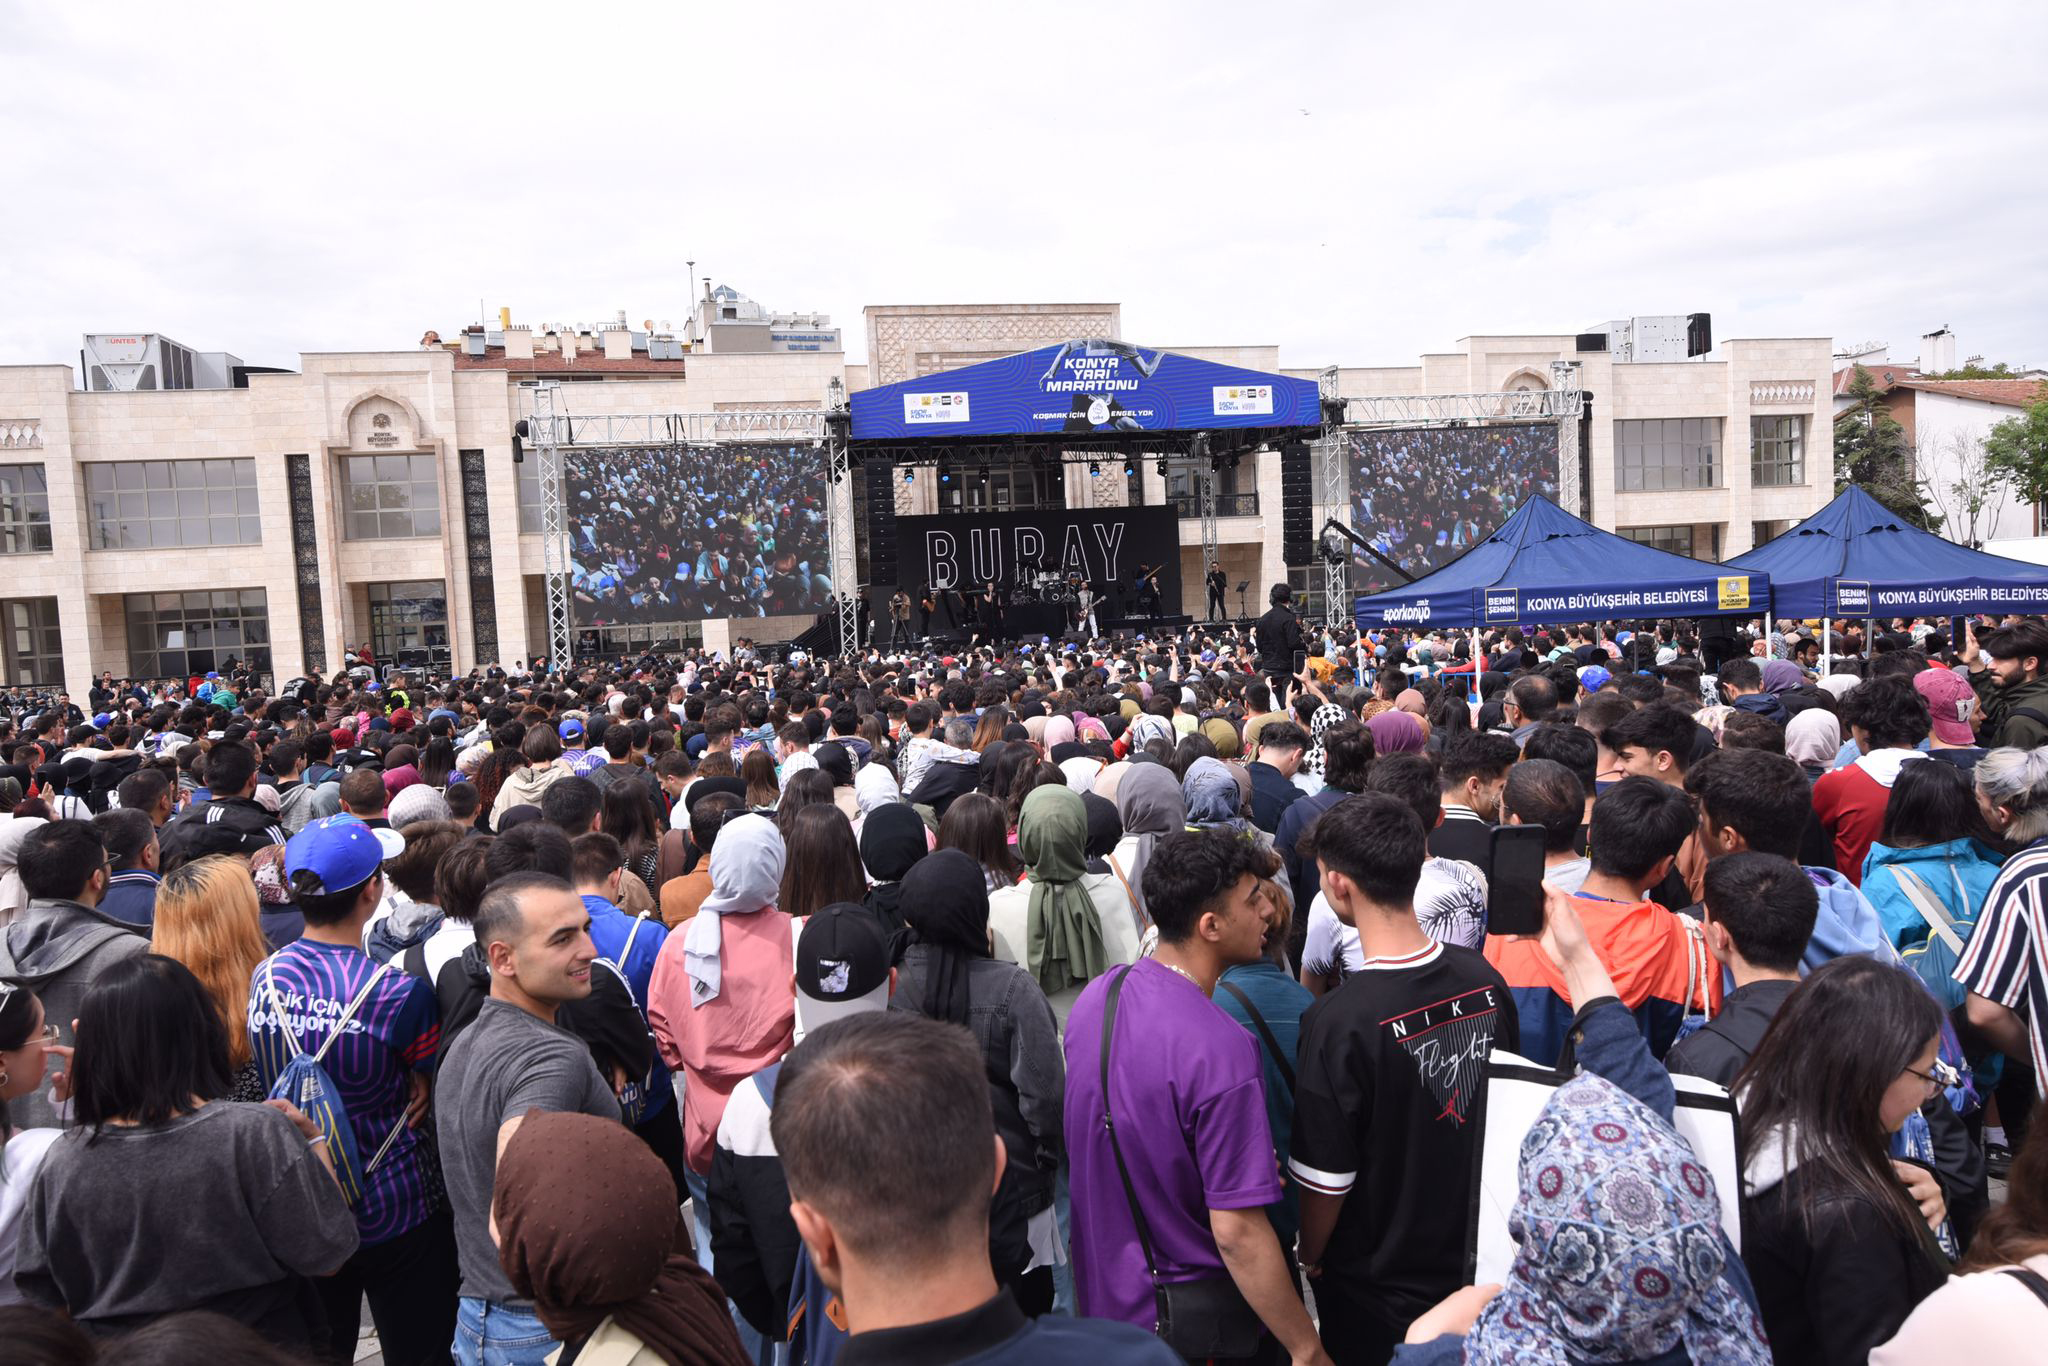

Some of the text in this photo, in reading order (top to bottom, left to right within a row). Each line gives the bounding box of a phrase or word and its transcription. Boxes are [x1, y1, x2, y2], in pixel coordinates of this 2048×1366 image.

[1064, 357, 1119, 369] KONYA
[1073, 369, 1110, 380] YARI
[1046, 379, 1138, 392] MARATONU
[1032, 412, 1067, 420] KOŞMAK
[1068, 411, 1086, 419] İÇİN
[926, 523, 1125, 592] BURAY
[1488, 596, 1515, 606] BENİM
[1527, 587, 1708, 611] KONYA BÜYÜKŞEHİR BELEDİYESİ
[1840, 588, 1867, 597] BENİM
[1878, 591, 1917, 605] KONYA
[1919, 586, 1988, 604] BÜYÜKŞEHİR
[1383, 604, 1431, 624] sporkonya
[307, 993, 351, 1018] İÇİN
[1392, 991, 1495, 1038] NIKE
[1414, 1032, 1493, 1088] Flight
